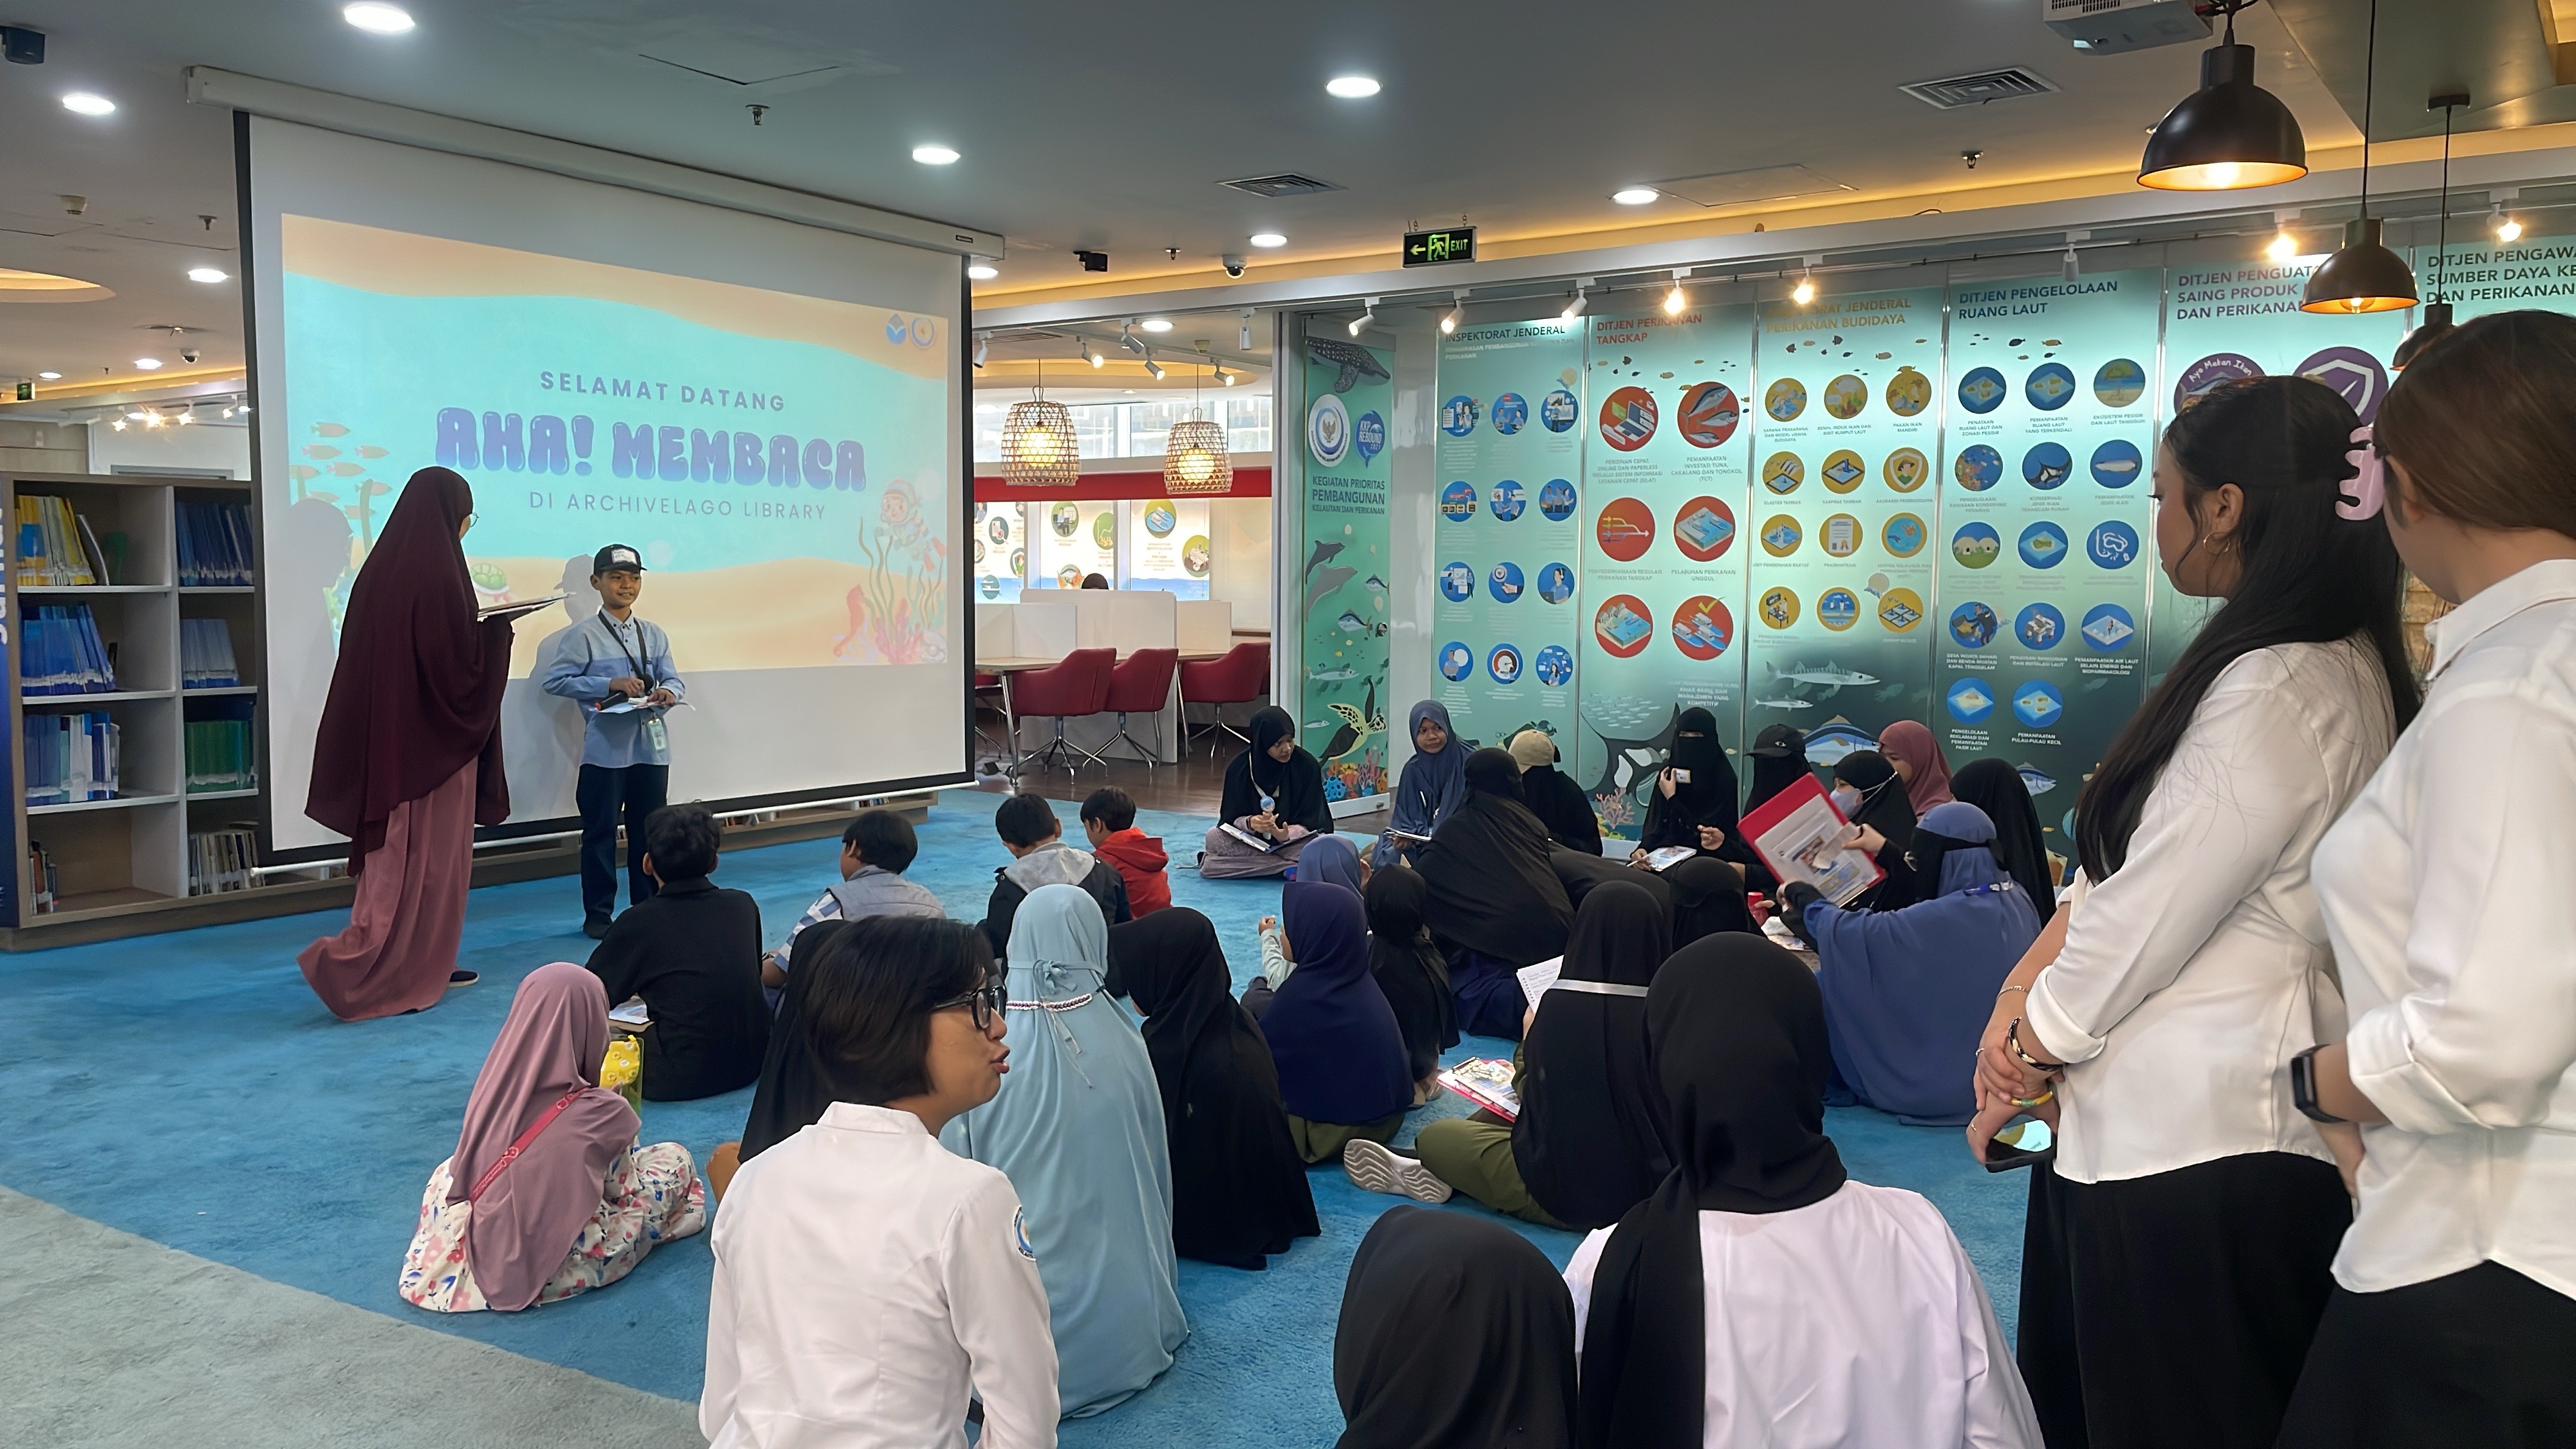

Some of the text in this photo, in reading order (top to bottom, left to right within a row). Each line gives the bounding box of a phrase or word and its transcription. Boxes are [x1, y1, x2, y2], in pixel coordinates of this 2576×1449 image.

[1451, 239, 1468, 251] EXIT
[2495, 246, 2576, 262] PENGAW
[2179, 272, 2231, 286] DITJEN
[2427, 270, 2497, 285] SUMBER
[2504, 267, 2550, 280] DAYA
[1959, 281, 2117, 304] DITJEN PENGELOLAAN
[2178, 289, 2225, 303] SAING
[2231, 284, 2298, 299] PRODUK
[2427, 283, 2575, 303] DAN PERIKANAN
[1846, 298, 1911, 312] JENDERAL
[1959, 303, 2048, 319] RUANG LAUT
[2178, 301, 2303, 320] DAN PERIKANA
[1597, 314, 1701, 332] DITJEN PERIKANAN
[1766, 313, 1906, 333] PERIKANAN BUDIDAYA
[1446, 326, 1565, 342] INSPEKTORAT JENDERAL
[1597, 332, 1648, 345] TANGKAP
[2189, 368, 2203, 382] Ayo
[540, 371, 785, 412] SELAMAT DATANG
[1360, 420, 1370, 431] KKP
[1359, 432, 1382, 443] REBOUND
[435, 407, 866, 492] AHA! MEMBACA
[1313, 476, 1385, 490] KEGIATAN PRIORITAS
[1313, 489, 1384, 504] PEMBANGUNAN
[530, 492, 826, 520] DI ARCHIVELAGO LIBRARY
